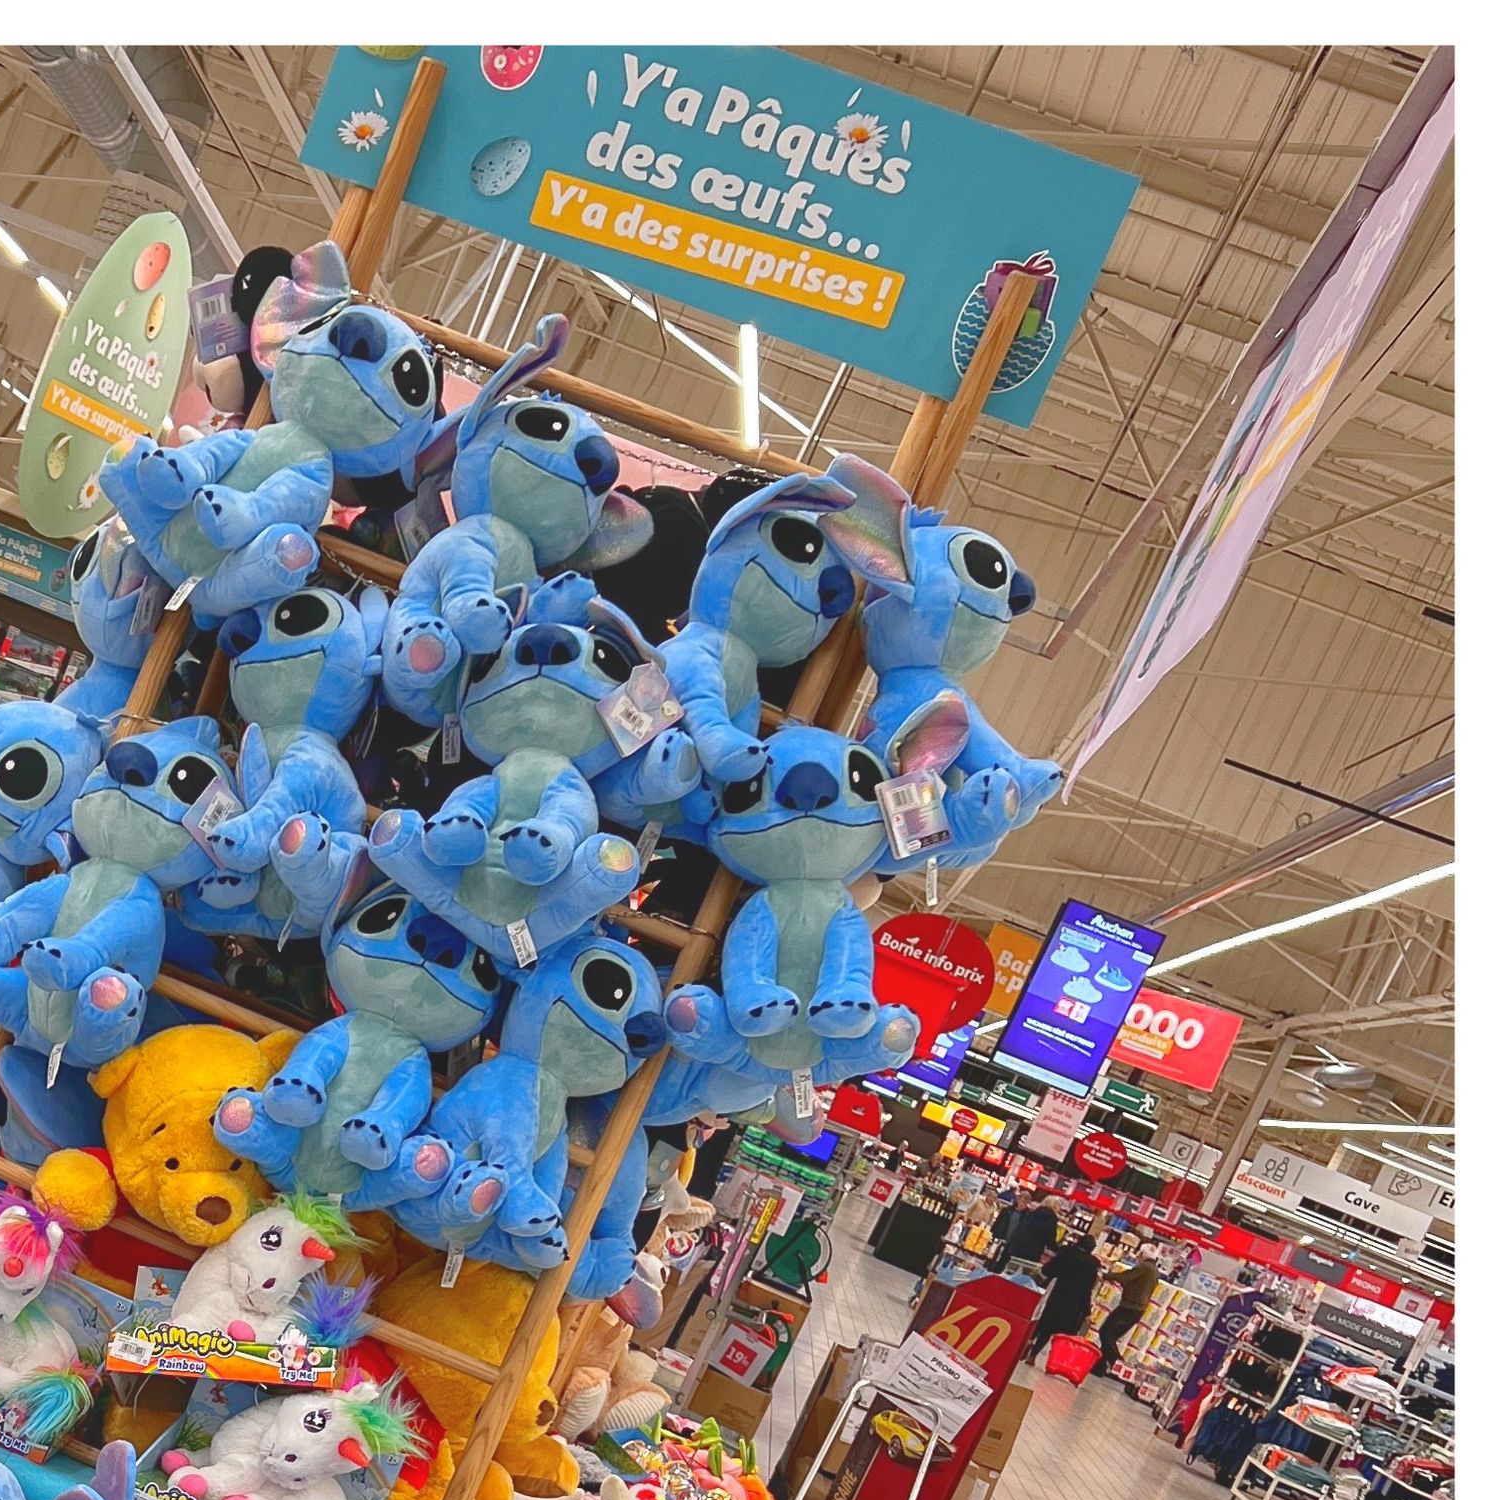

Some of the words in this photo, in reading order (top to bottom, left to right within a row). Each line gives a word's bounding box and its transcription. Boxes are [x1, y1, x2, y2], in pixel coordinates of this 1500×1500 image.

[622, 53, 703, 127] Y'a
[705, 85, 911, 194] Pâques
[585, 120, 683, 190] des
[691, 167, 880, 260] œufs...
[549, 180, 609, 230] Y'a
[614, 204, 683, 250] des
[686, 231, 869, 305] surprises
[69, 353, 99, 387] des
[85, 319, 109, 356] Y'a
[107, 336, 163, 389] Pâques
[69, 397, 91, 420] des
[880, 932, 925, 960] Borne
[924, 949, 953, 973] info
[954, 964, 985, 985] prix
[1237, 1172, 1287, 1199] discount
[1345, 1191, 1381, 1214] Cave
[924, 1305, 1011, 1366] 60
[1339, 1316, 1361, 1332] MODE
[1361, 1325, 1372, 1337] DE
[1372, 1330, 1402, 1349] SAISON
[159, 1358, 205, 1372] Rainbow
[280, 1369, 296, 1380] Try
[931, 1357, 961, 1380] PROMO
